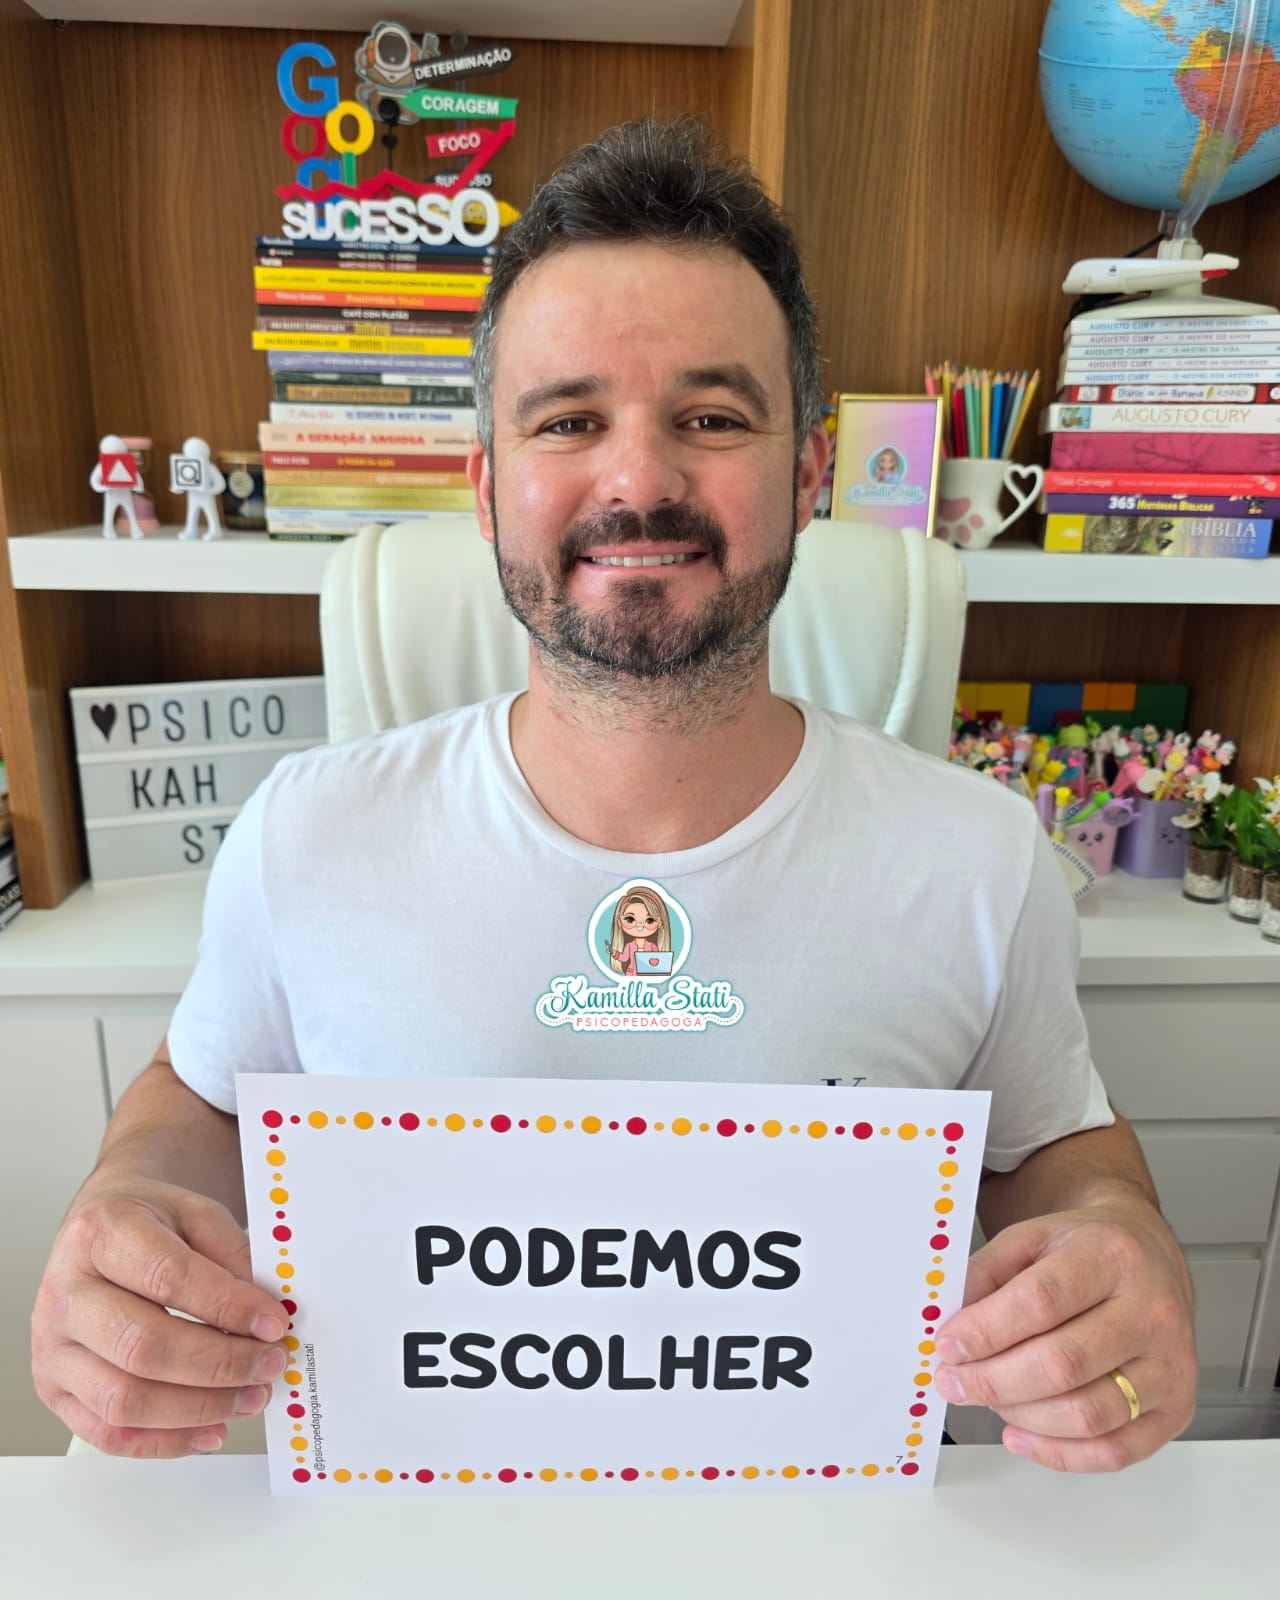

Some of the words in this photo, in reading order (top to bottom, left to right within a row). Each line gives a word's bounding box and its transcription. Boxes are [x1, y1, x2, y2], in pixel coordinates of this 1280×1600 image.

[414, 48, 512, 80] DETERMINAÇÃO
[421, 95, 500, 115] CORAGEM
[438, 133, 482, 153] FOCO
[282, 188, 501, 247] SUCESSO
[341, 308, 361, 319] CAFÉ
[1088, 321, 1130, 331] AUGUSTO
[1131, 320, 1155, 330] CURY
[1187, 320, 1214, 328] MESTRE
[1089, 335, 1130, 344] AUGUSTO
[1131, 334, 1155, 343] CURY
[1215, 333, 1228, 341] DO
[1229, 332, 1251, 340] AMOR
[1084, 347, 1125, 356] AUGUSTO
[1126, 346, 1150, 355] CURY
[1222, 345, 1240, 353] VIDA
[1088, 360, 1128, 369] AUGUSTO
[1130, 359, 1153, 368] CURY
[1085, 373, 1126, 382] AUGUSTO
[1127, 372, 1151, 381] CURY
[1118, 387, 1144, 398] Diário
[1171, 388, 1204, 398] Banana
[1112, 407, 1199, 423] AUGUSTO
[1202, 408, 1252, 424] CURY
[296, 433, 305, 443] A
[308, 431, 367, 447] GERAÇÃO
[370, 435, 425, 445] ANSIOSA
[1076, 478, 1113, 489] Carnegie
[1108, 495, 1136, 510] 365
[1190, 518, 1257, 538] BÍBLIA
[127, 695, 285, 744] PSICO
[131, 763, 218, 809] KAH
[415, 1225, 802, 1290] PODEMOS
[403, 1331, 813, 1390] ESCOLHER
[304, 1343, 326, 1472] @psicopedagogia.kamillastati
[895, 1455, 904, 1464] 7
